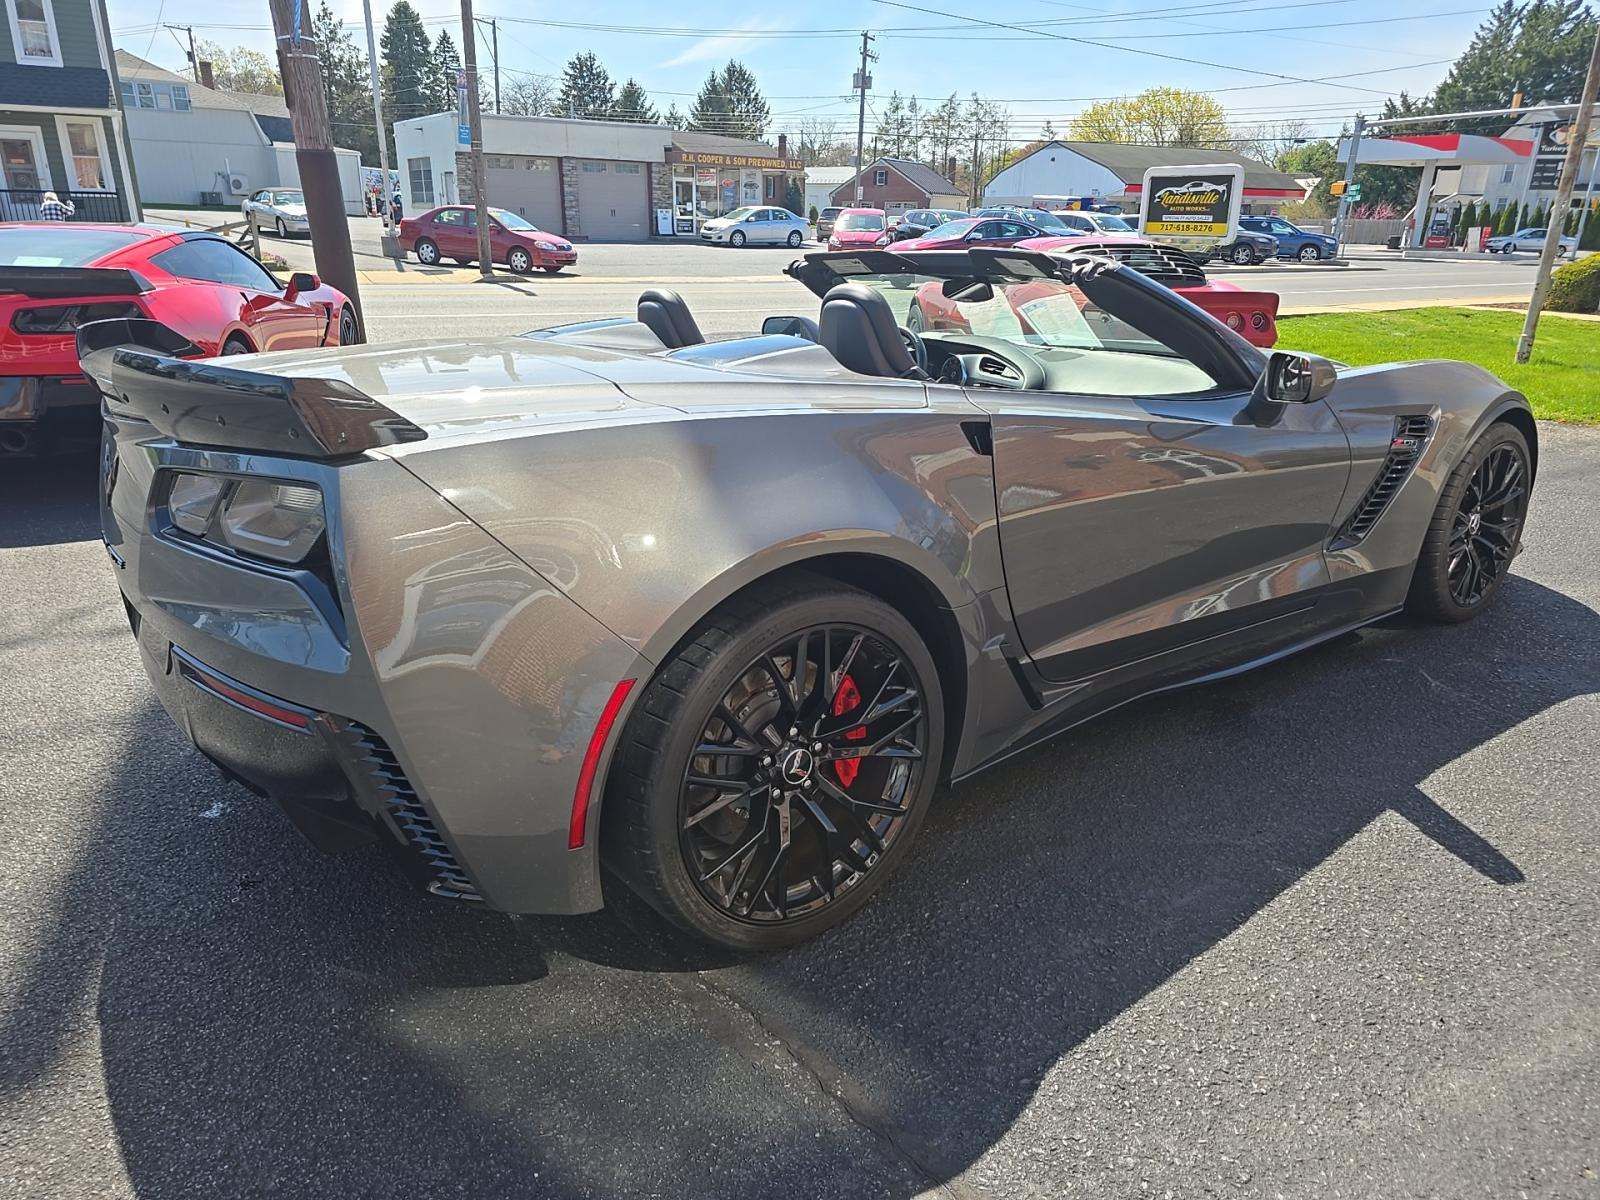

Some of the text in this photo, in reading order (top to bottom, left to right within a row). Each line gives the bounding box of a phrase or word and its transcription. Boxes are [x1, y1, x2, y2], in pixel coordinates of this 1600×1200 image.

[697, 154, 724, 165] COOPER
[725, 156, 731, 165] &
[733, 157, 747, 166] SON
[789, 161, 802, 169] LLC
[1161, 192, 1218, 207] Landisville
